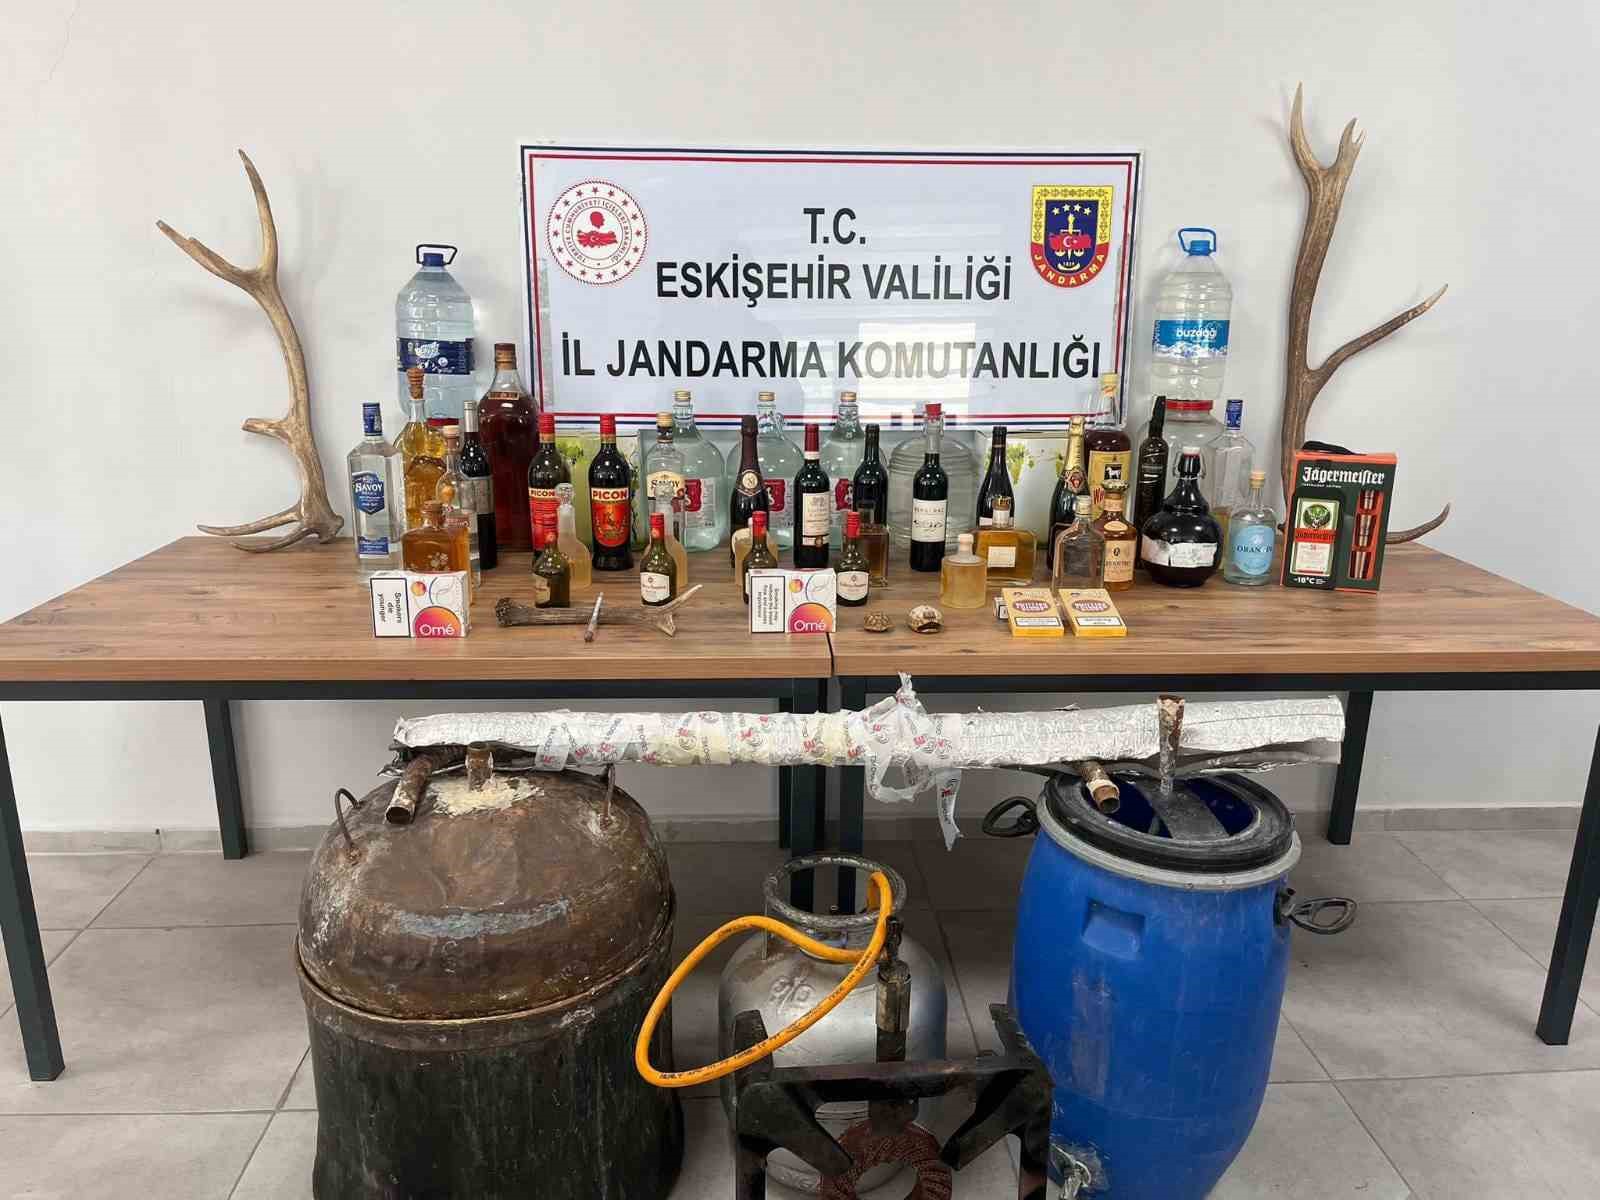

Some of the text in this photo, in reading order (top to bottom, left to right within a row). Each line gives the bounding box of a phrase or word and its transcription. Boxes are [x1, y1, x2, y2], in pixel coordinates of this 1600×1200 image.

[803, 207, 866, 245] T.C.
[656, 252, 1012, 308] ESKİŞEHİR VALİLİĞİ
[1033, 253, 1105, 285] JANDARMA
[561, 331, 1101, 380] İL JANDARMA KOMUTANLIĞI
[1302, 465, 1386, 486] Jägermeister
[530, 488, 556, 497] PICON
[592, 489, 628, 500] PICON
[377, 593, 386, 623] younger
[419, 623, 455, 636] Omé
[794, 619, 827, 631] Omé
